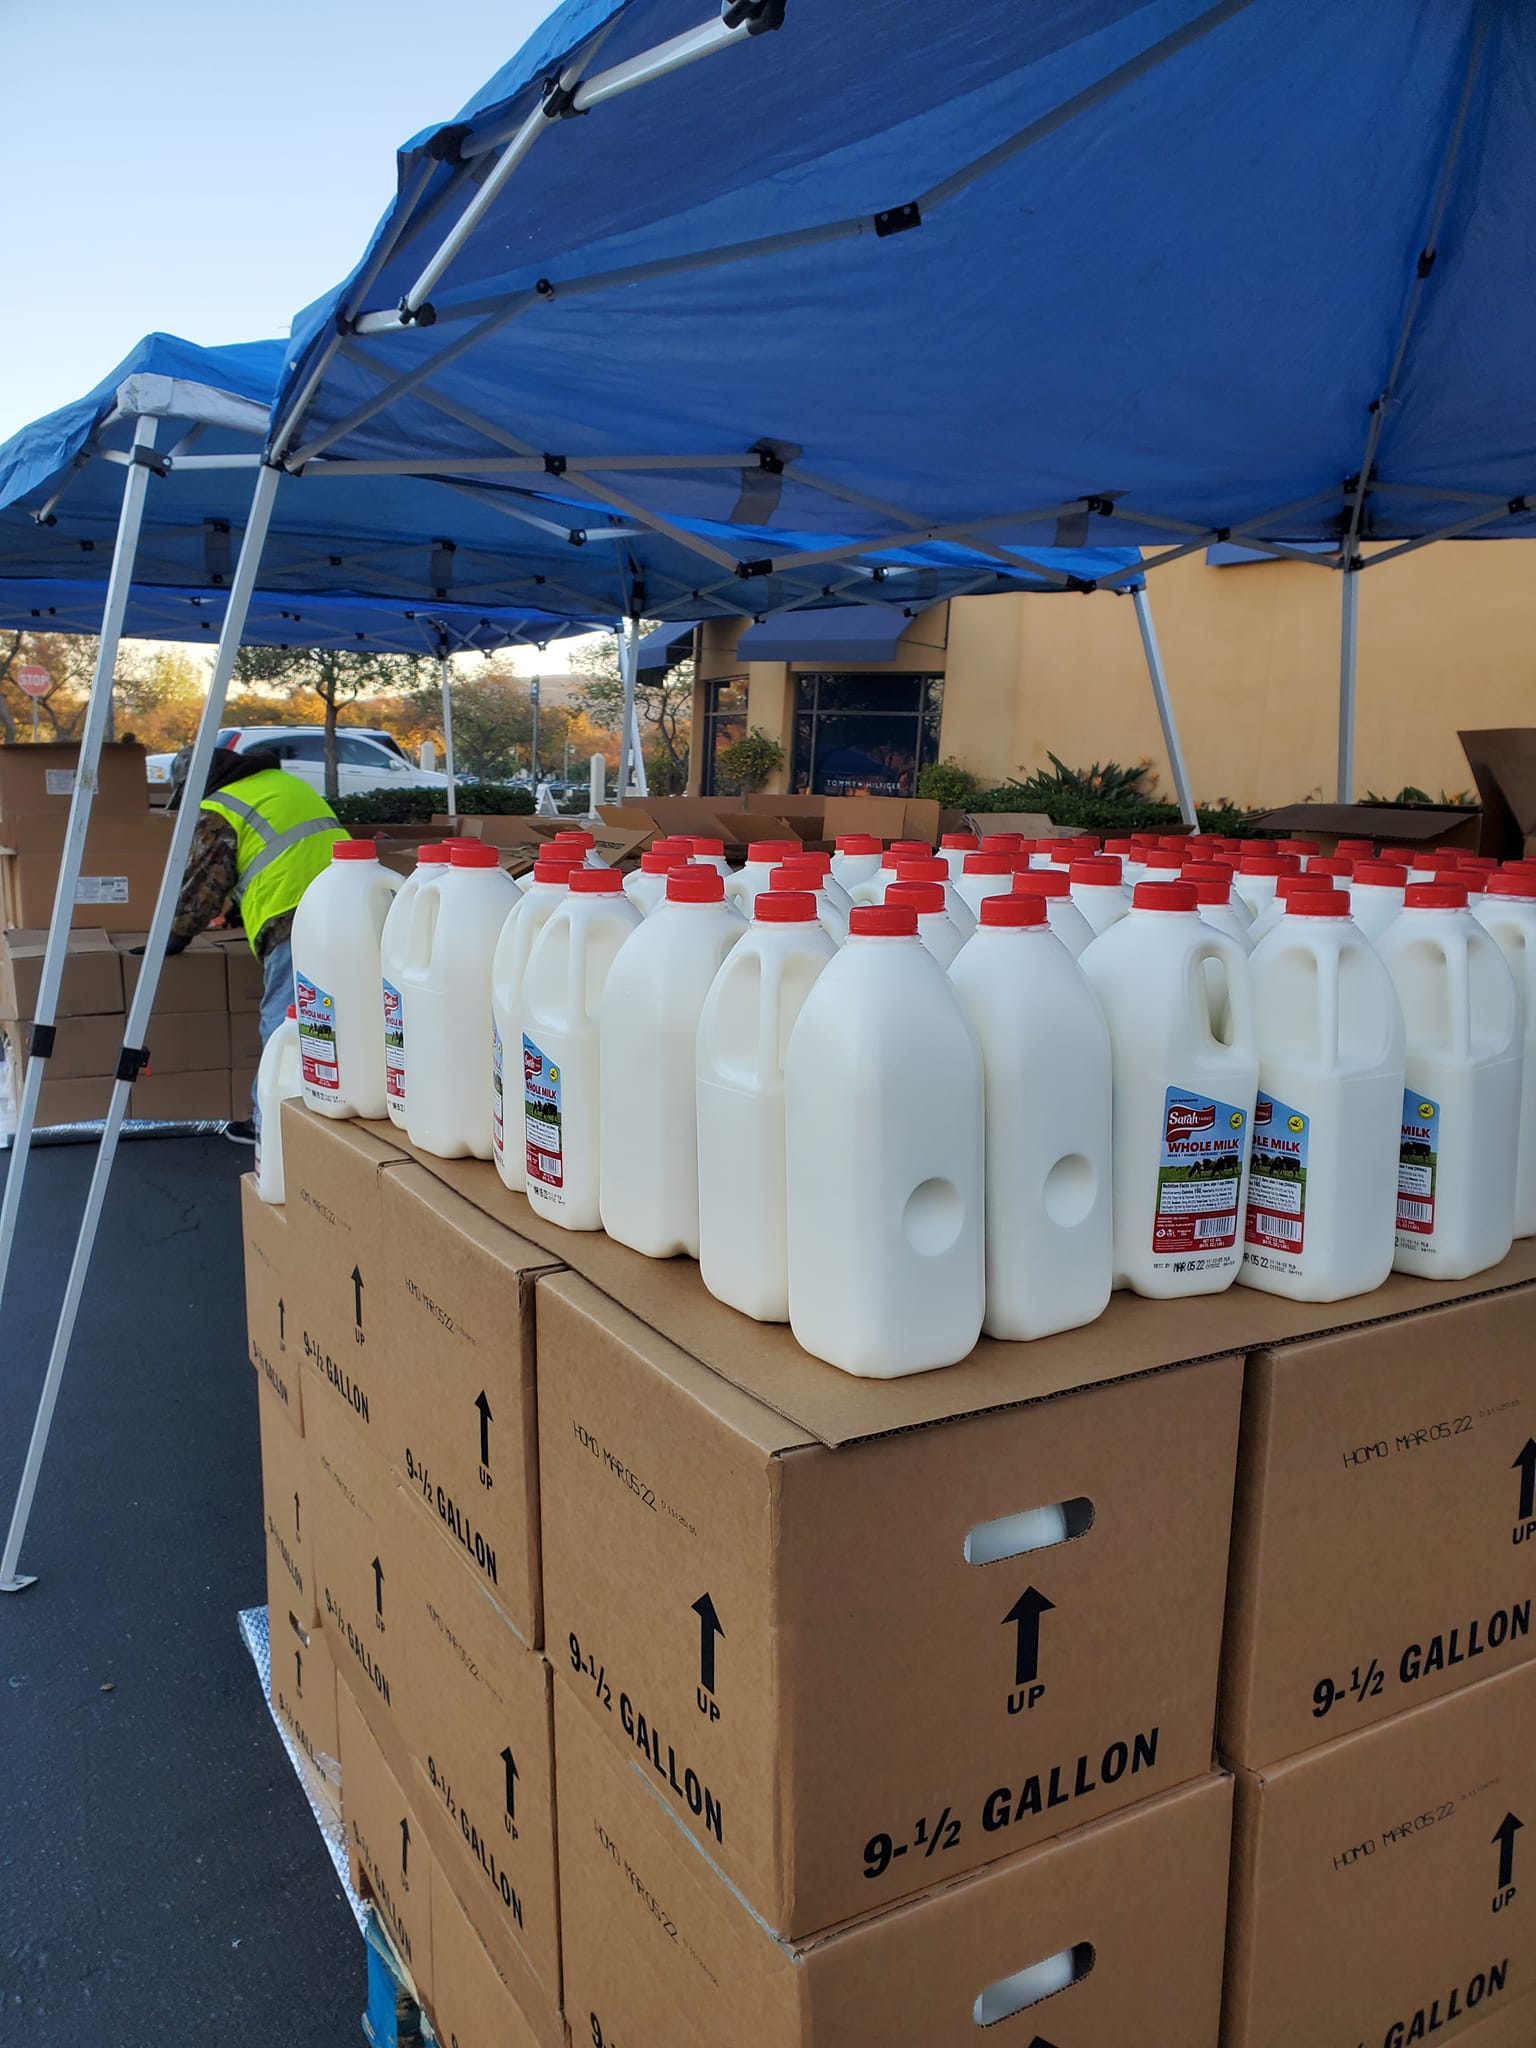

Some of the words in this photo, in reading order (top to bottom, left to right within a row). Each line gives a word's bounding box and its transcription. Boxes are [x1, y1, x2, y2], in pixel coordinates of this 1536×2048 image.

[18, 674, 50, 687] STOP
[826, 779, 856, 787] TOMMY
[1168, 1111, 1199, 1125] Sarah
[1401, 1125, 1431, 1138] MILK
[1167, 1141, 1211, 1153] WHOLE
[1213, 1138, 1239, 1151] MILK
[1270, 1138, 1301, 1153] MILK
[1196, 1259, 1206, 1270] 22
[1250, 1254, 1260, 1266] 05
[1260, 1256, 1269, 1269] 22
[355, 1327, 365, 1347] UP
[326, 1355, 370, 1425] GALLON
[479, 1466, 493, 1491] UP
[436, 1485, 498, 1586] GALLON
[1511, 1521, 1536, 1546] UP
[1399, 1599, 1531, 1685] GALLON
[346, 1622, 391, 1708] GALLON
[697, 1686, 721, 1723] UP
[1006, 1684, 1046, 1715] UP
[619, 1692, 723, 1845] GALLON
[981, 1726, 1160, 1833] GALLON
[504, 1813, 519, 1841] UP
[460, 1807, 524, 1931] GALLON
[373, 1863, 413, 1964] GALLON
[1492, 1886, 1516, 1914] UP
[1383, 1957, 1510, 2048] GALLON
